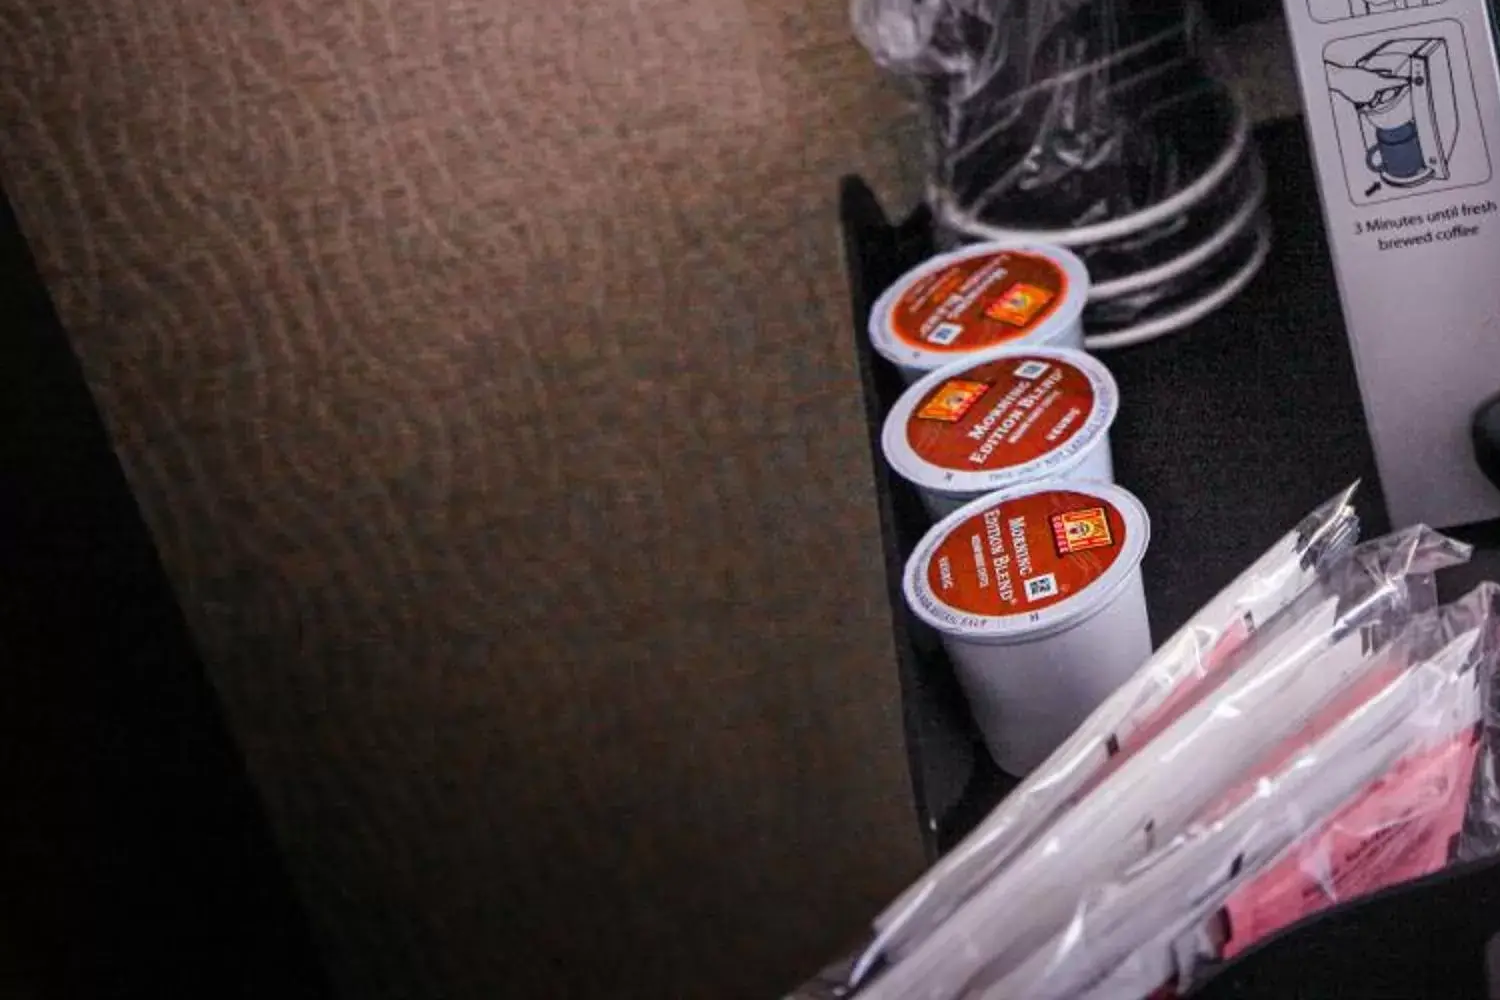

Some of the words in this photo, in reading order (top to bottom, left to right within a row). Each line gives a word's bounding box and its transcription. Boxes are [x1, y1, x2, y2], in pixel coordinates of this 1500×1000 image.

[1365, 214, 1425, 233] Minutes
[1426, 205, 1460, 223] until
[1460, 200, 1498, 217] fresh
[1377, 230, 1433, 251] brewed
[1435, 224, 1480, 241] coffee
